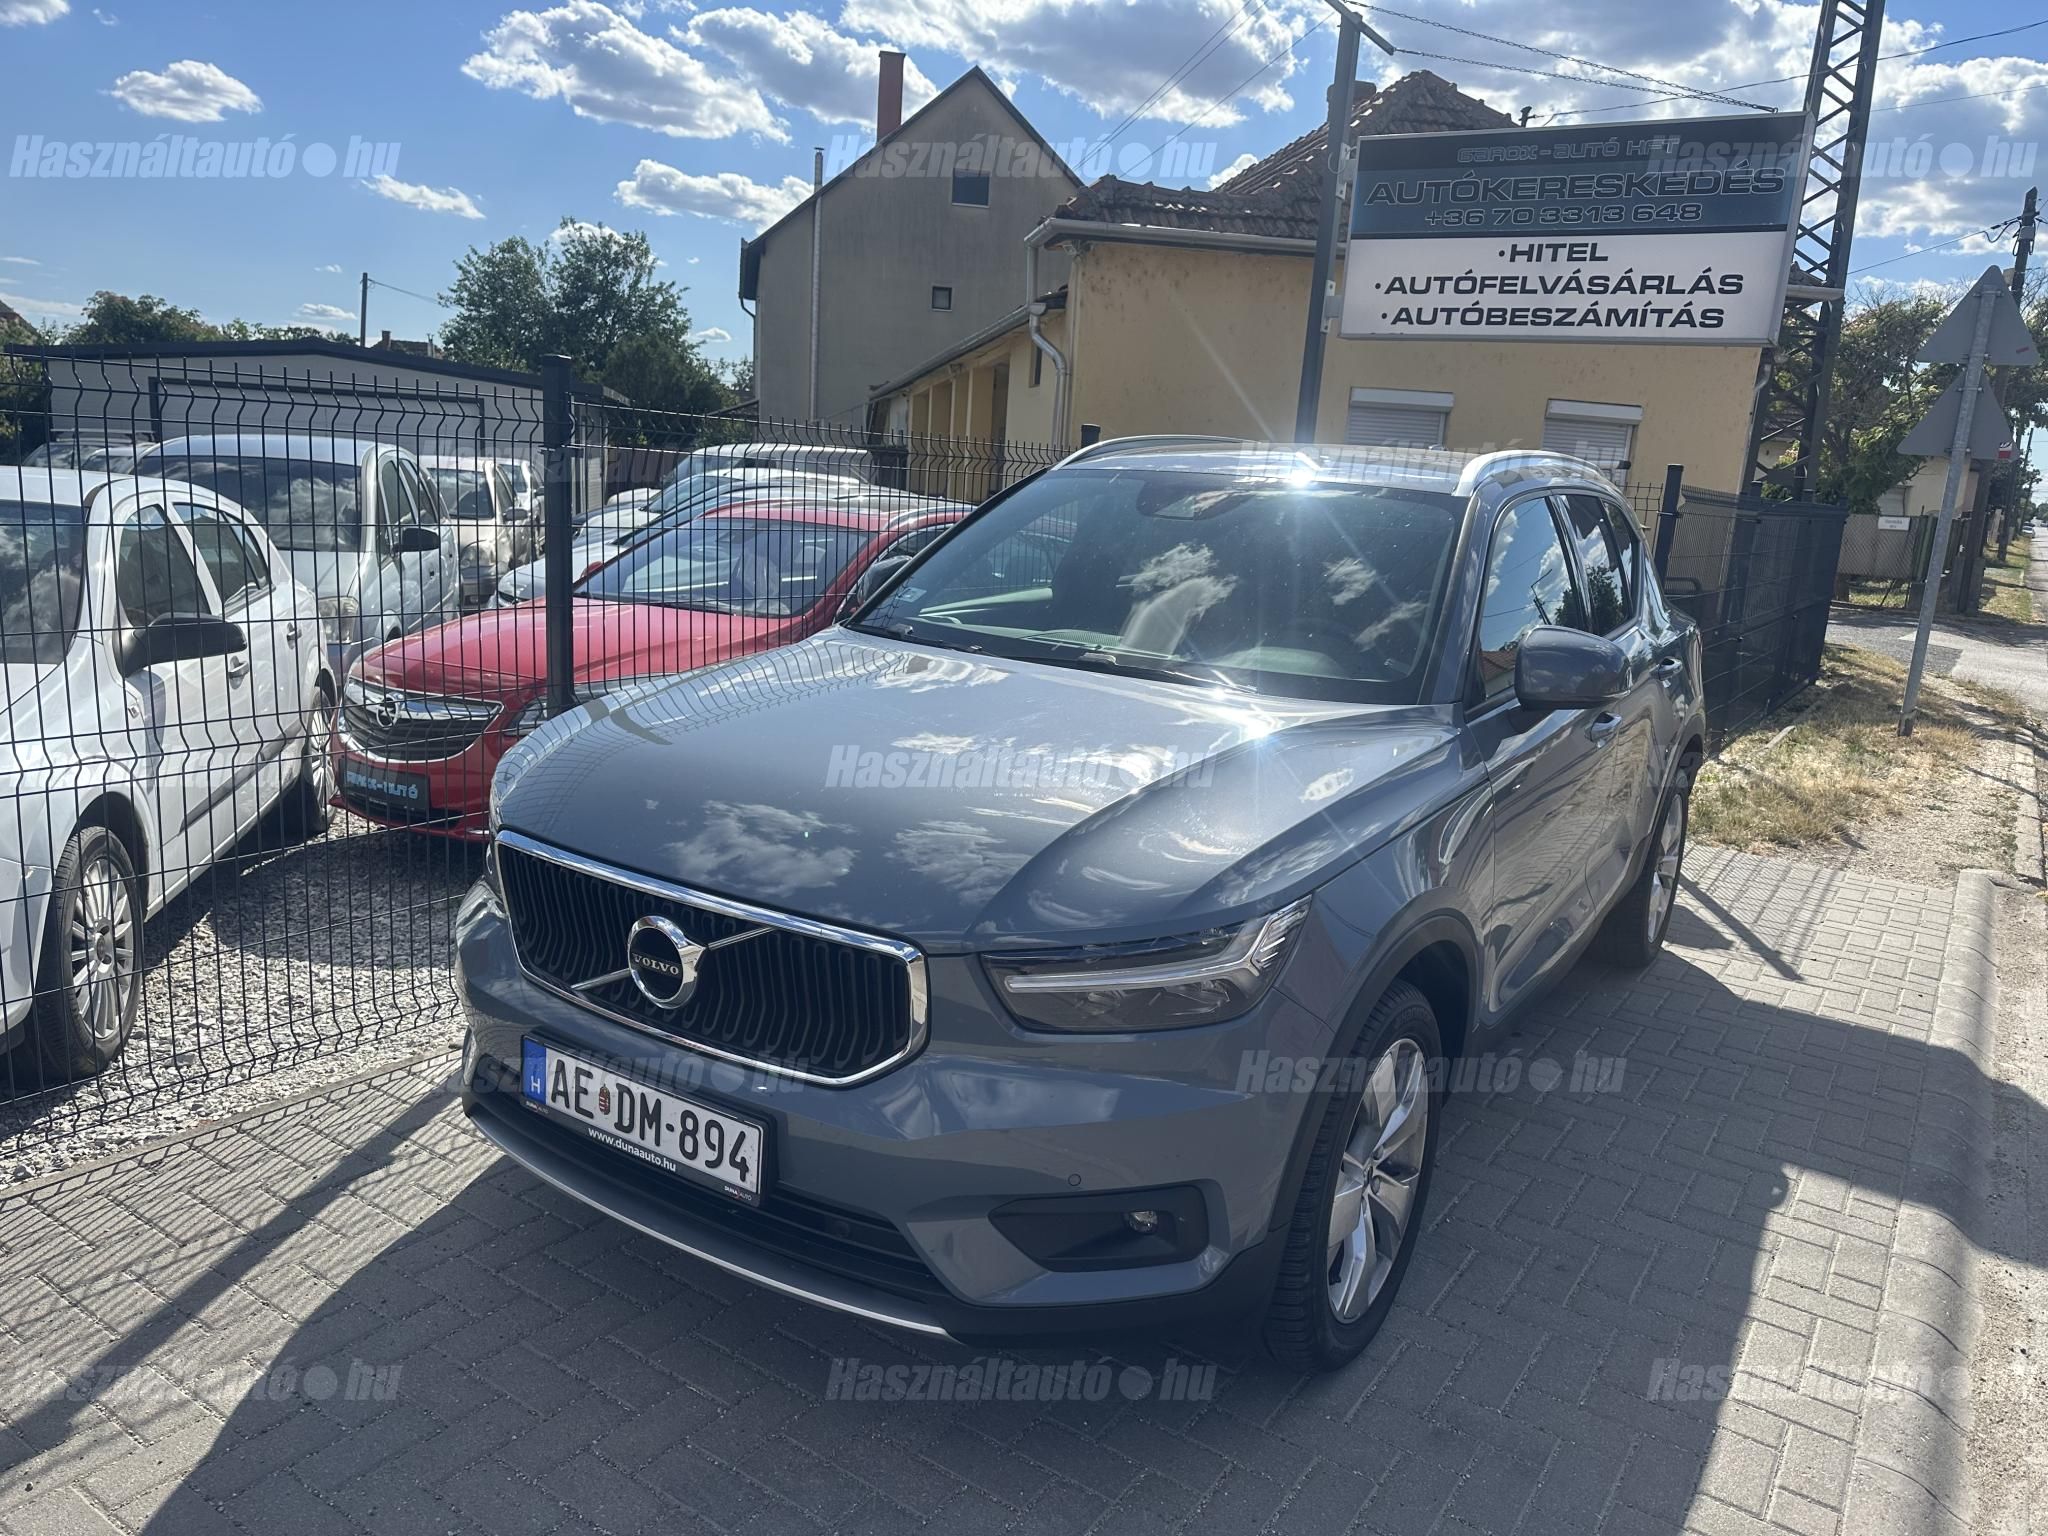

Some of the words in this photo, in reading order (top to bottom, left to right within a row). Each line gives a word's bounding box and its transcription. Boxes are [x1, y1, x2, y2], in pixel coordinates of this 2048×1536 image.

[1367, 159, 1785, 205] AUTÓKERESKEDÉS
[1425, 209, 1485, 226] +36
[1492, 208, 1534, 225] 70
[1539, 205, 1625, 224] 3313
[1631, 203, 1703, 222] 648
[631, 952, 679, 976] VOLVO
[551, 1059, 594, 1119] AE
[587, 1127, 676, 1173] www.dunaauto.hu
